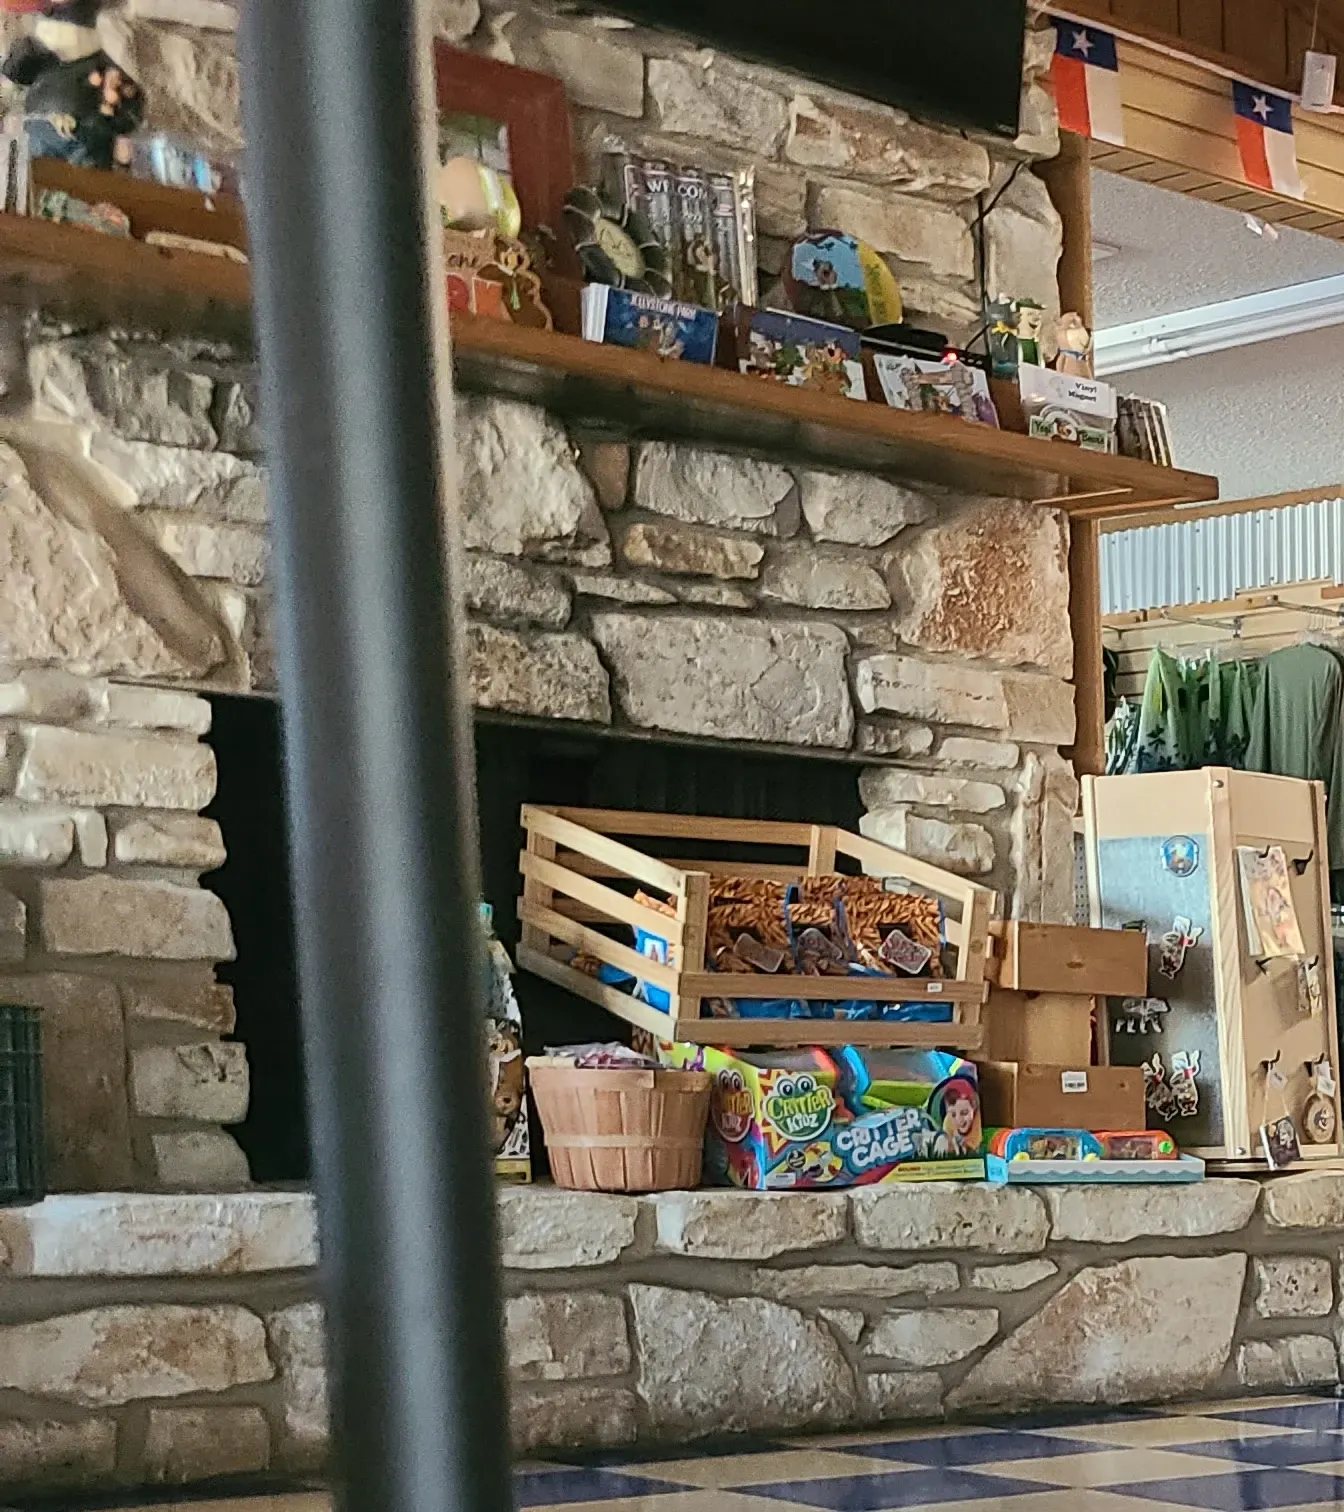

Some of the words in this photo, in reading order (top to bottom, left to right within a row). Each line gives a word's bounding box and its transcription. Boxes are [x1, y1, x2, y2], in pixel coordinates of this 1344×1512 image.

[767, 1089, 832, 1119] CRITTER
[836, 1107, 921, 1151] CRITTER
[851, 1130, 914, 1168] CAGE
